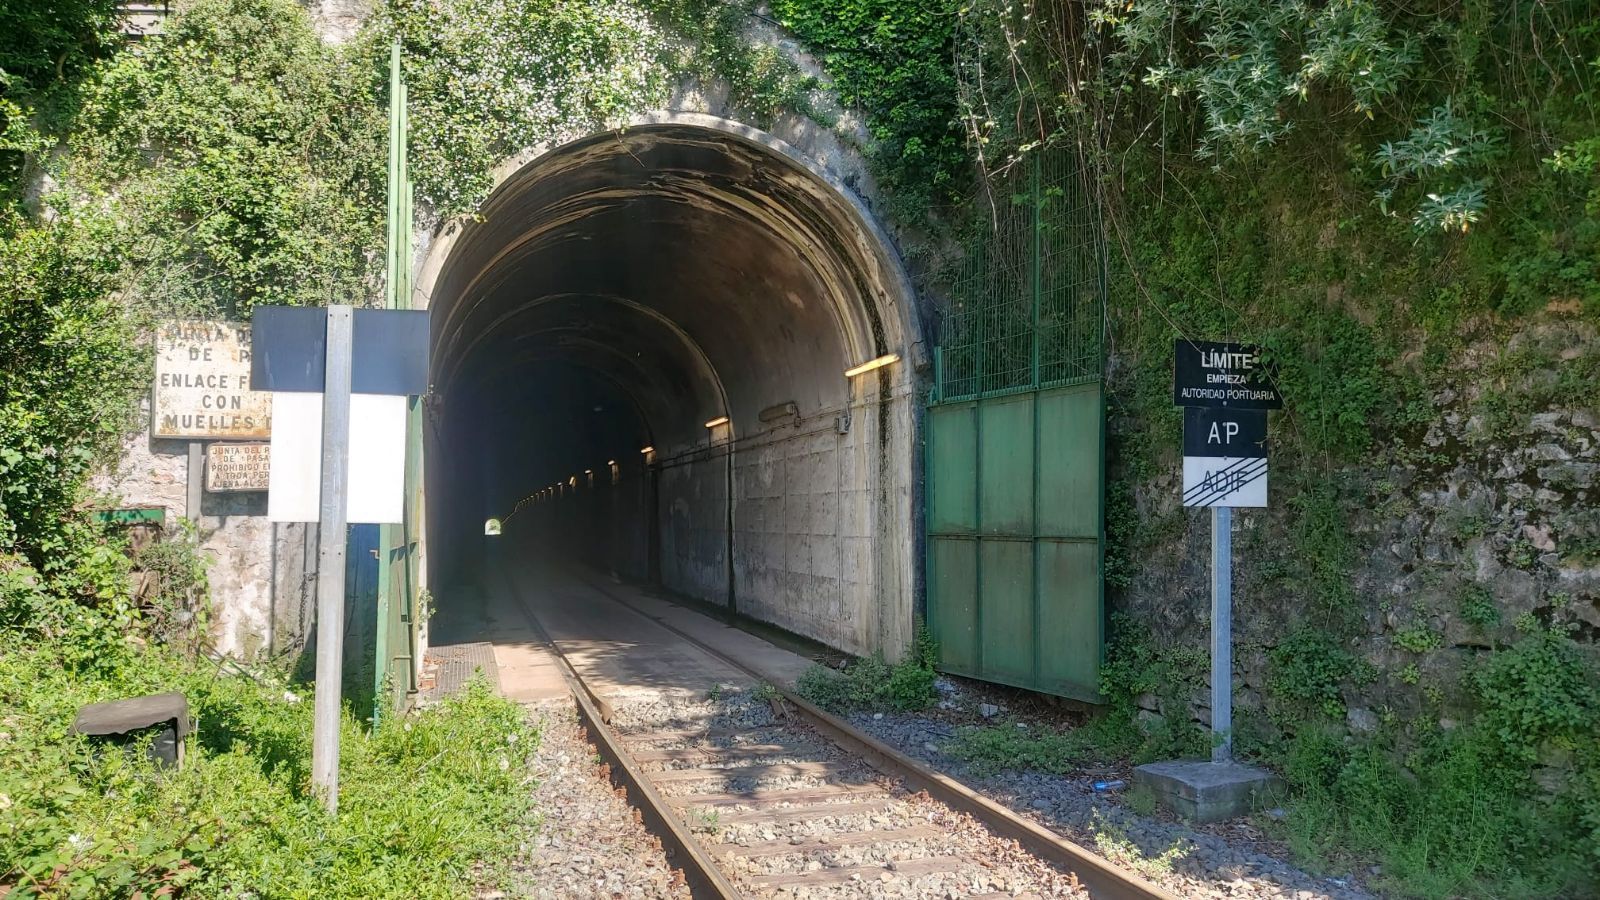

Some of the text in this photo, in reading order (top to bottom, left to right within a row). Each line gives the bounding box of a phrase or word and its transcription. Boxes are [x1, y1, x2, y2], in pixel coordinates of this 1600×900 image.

[189, 347, 213, 362] DE
[1201, 348, 1253, 369] LÍMITE
[160, 373, 228, 388] ENLACE
[1206, 373, 1247, 384] EMPIEZA
[1181, 387, 1275, 401] AUTORIDAD PORTUARIA
[202, 395, 241, 410] CON
[165, 414, 254, 430] MUELLES
[1207, 421, 1239, 444] AP
[212, 447, 240, 455] JUNTA
[244, 446, 261, 454] DEL
[223, 455, 235, 463] DE
[211, 463, 259, 472] PROHIBIDO
[215, 472, 220, 480] A
[225, 472, 248, 480] TODA
[1201, 470, 1248, 492] ADIF
